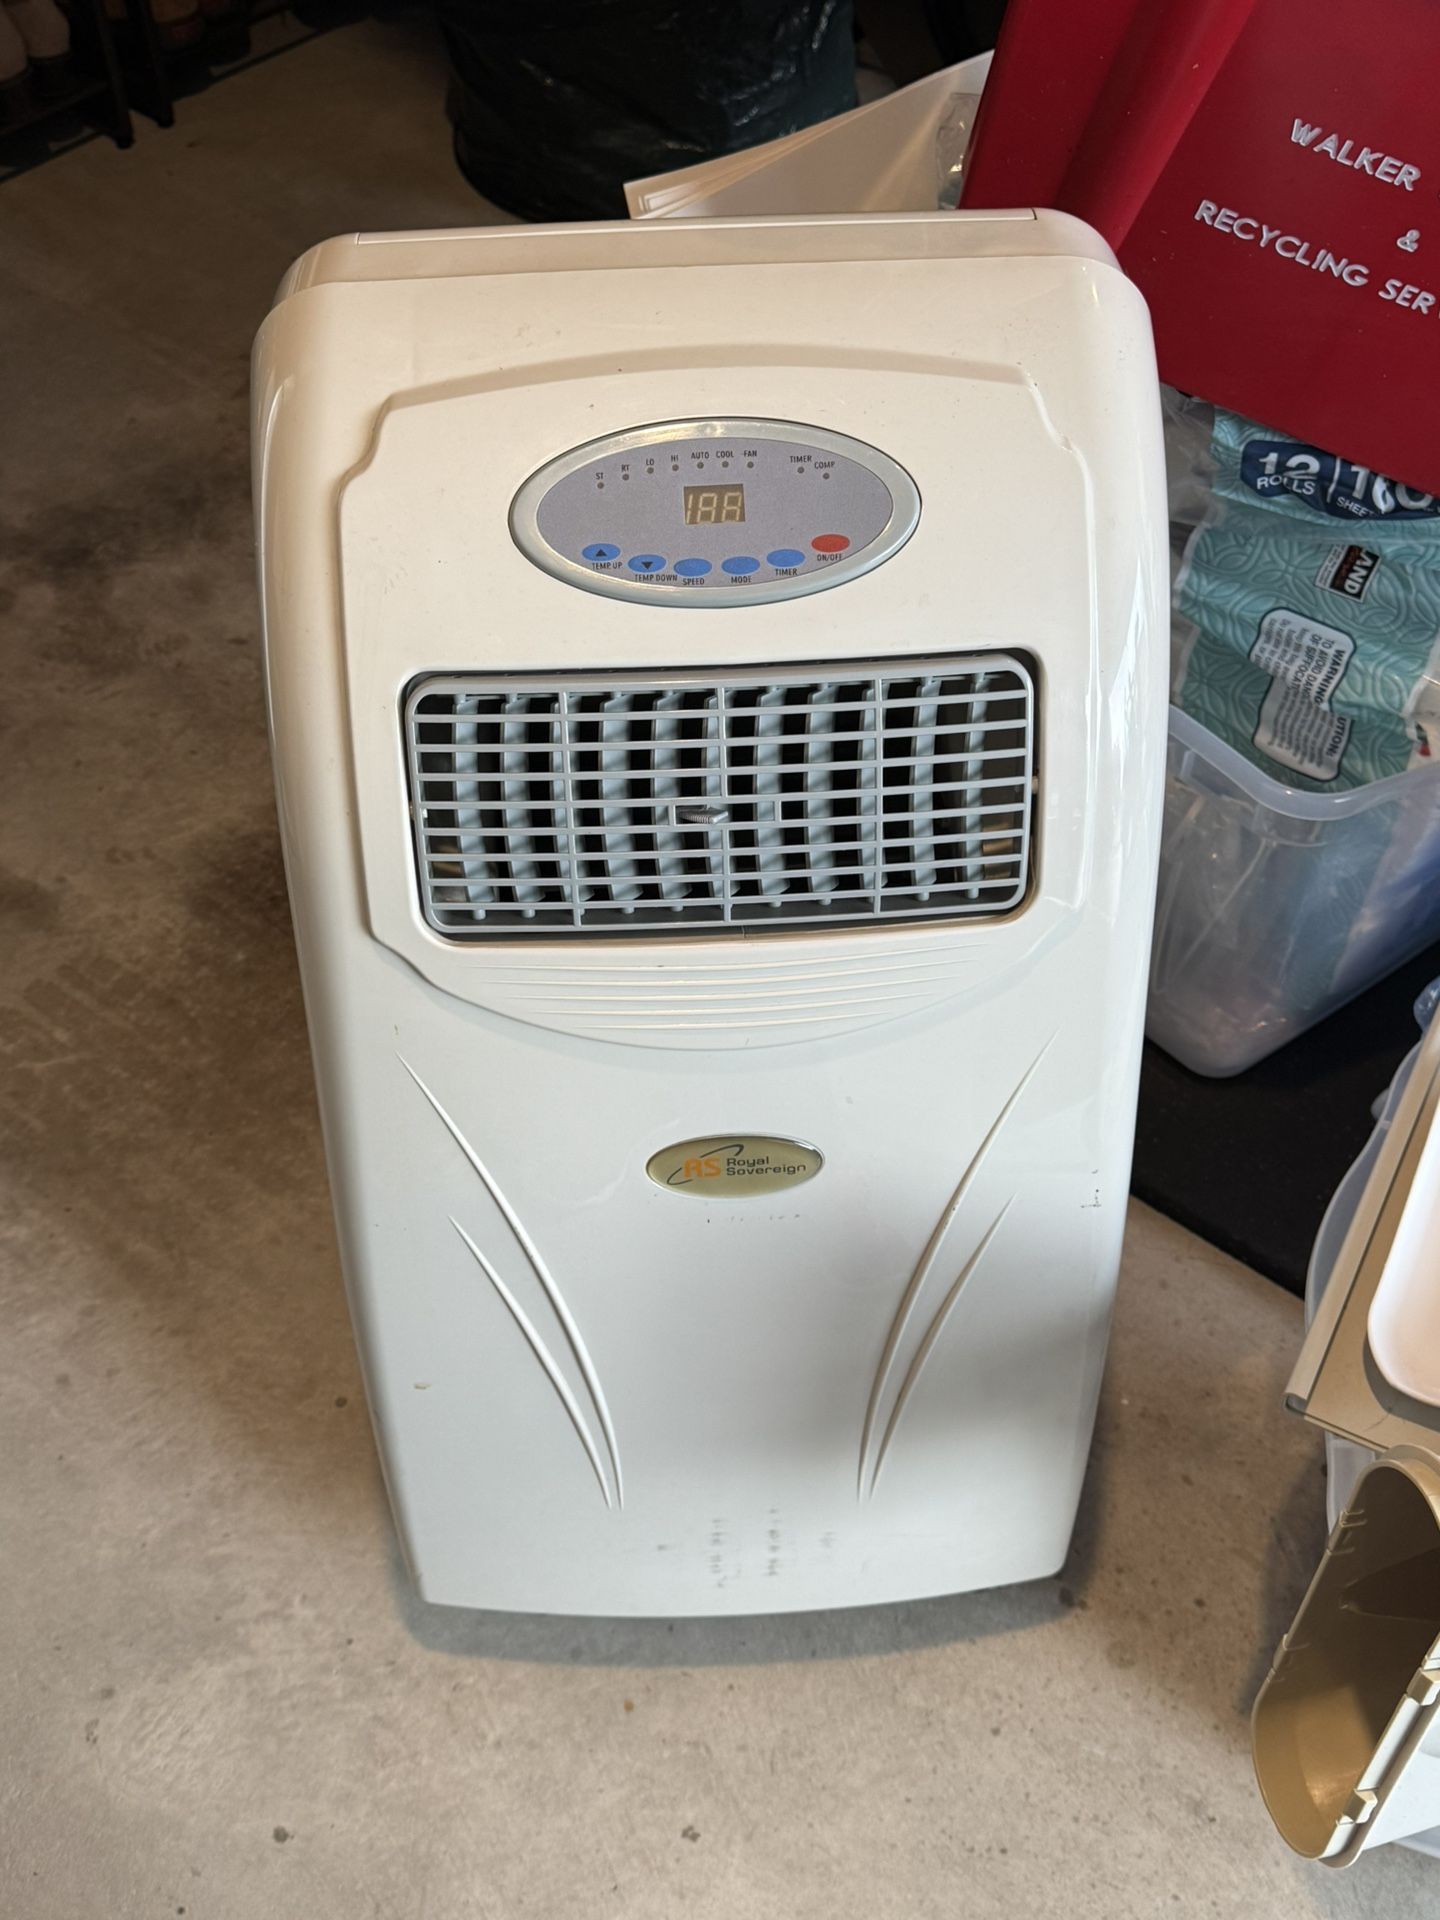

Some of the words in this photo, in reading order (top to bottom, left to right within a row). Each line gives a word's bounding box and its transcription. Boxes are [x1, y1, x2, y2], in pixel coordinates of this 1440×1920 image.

[1290, 118, 1421, 191] WALKER
[1397, 229, 1420, 252] &
[1194, 199, 1370, 287] RECYCLING
[1378, 279, 1440, 318] SER
[691, 452, 710, 460] AUTO
[790, 455, 812, 463] TIMER
[646, 458, 655, 466] LO
[814, 461, 835, 470] COMP
[1259, 452, 1320, 480] 12
[1256, 475, 1316, 495] ROLLS
[817, 553, 843, 561] ON/OFF
[592, 562, 610, 571] TEMP
[612, 561, 623, 569] UP
[1343, 548, 1374, 594] AND
[775, 568, 798, 576] TIMER
[635, 574, 654, 582] TEMP
[656, 574, 678, 582] DOWN
[682, 577, 705, 586] SPEED
[1313, 648, 1346, 706] WARNING
[726, 1156, 769, 1167] Royal
[726, 1164, 807, 1176] Sovereign
